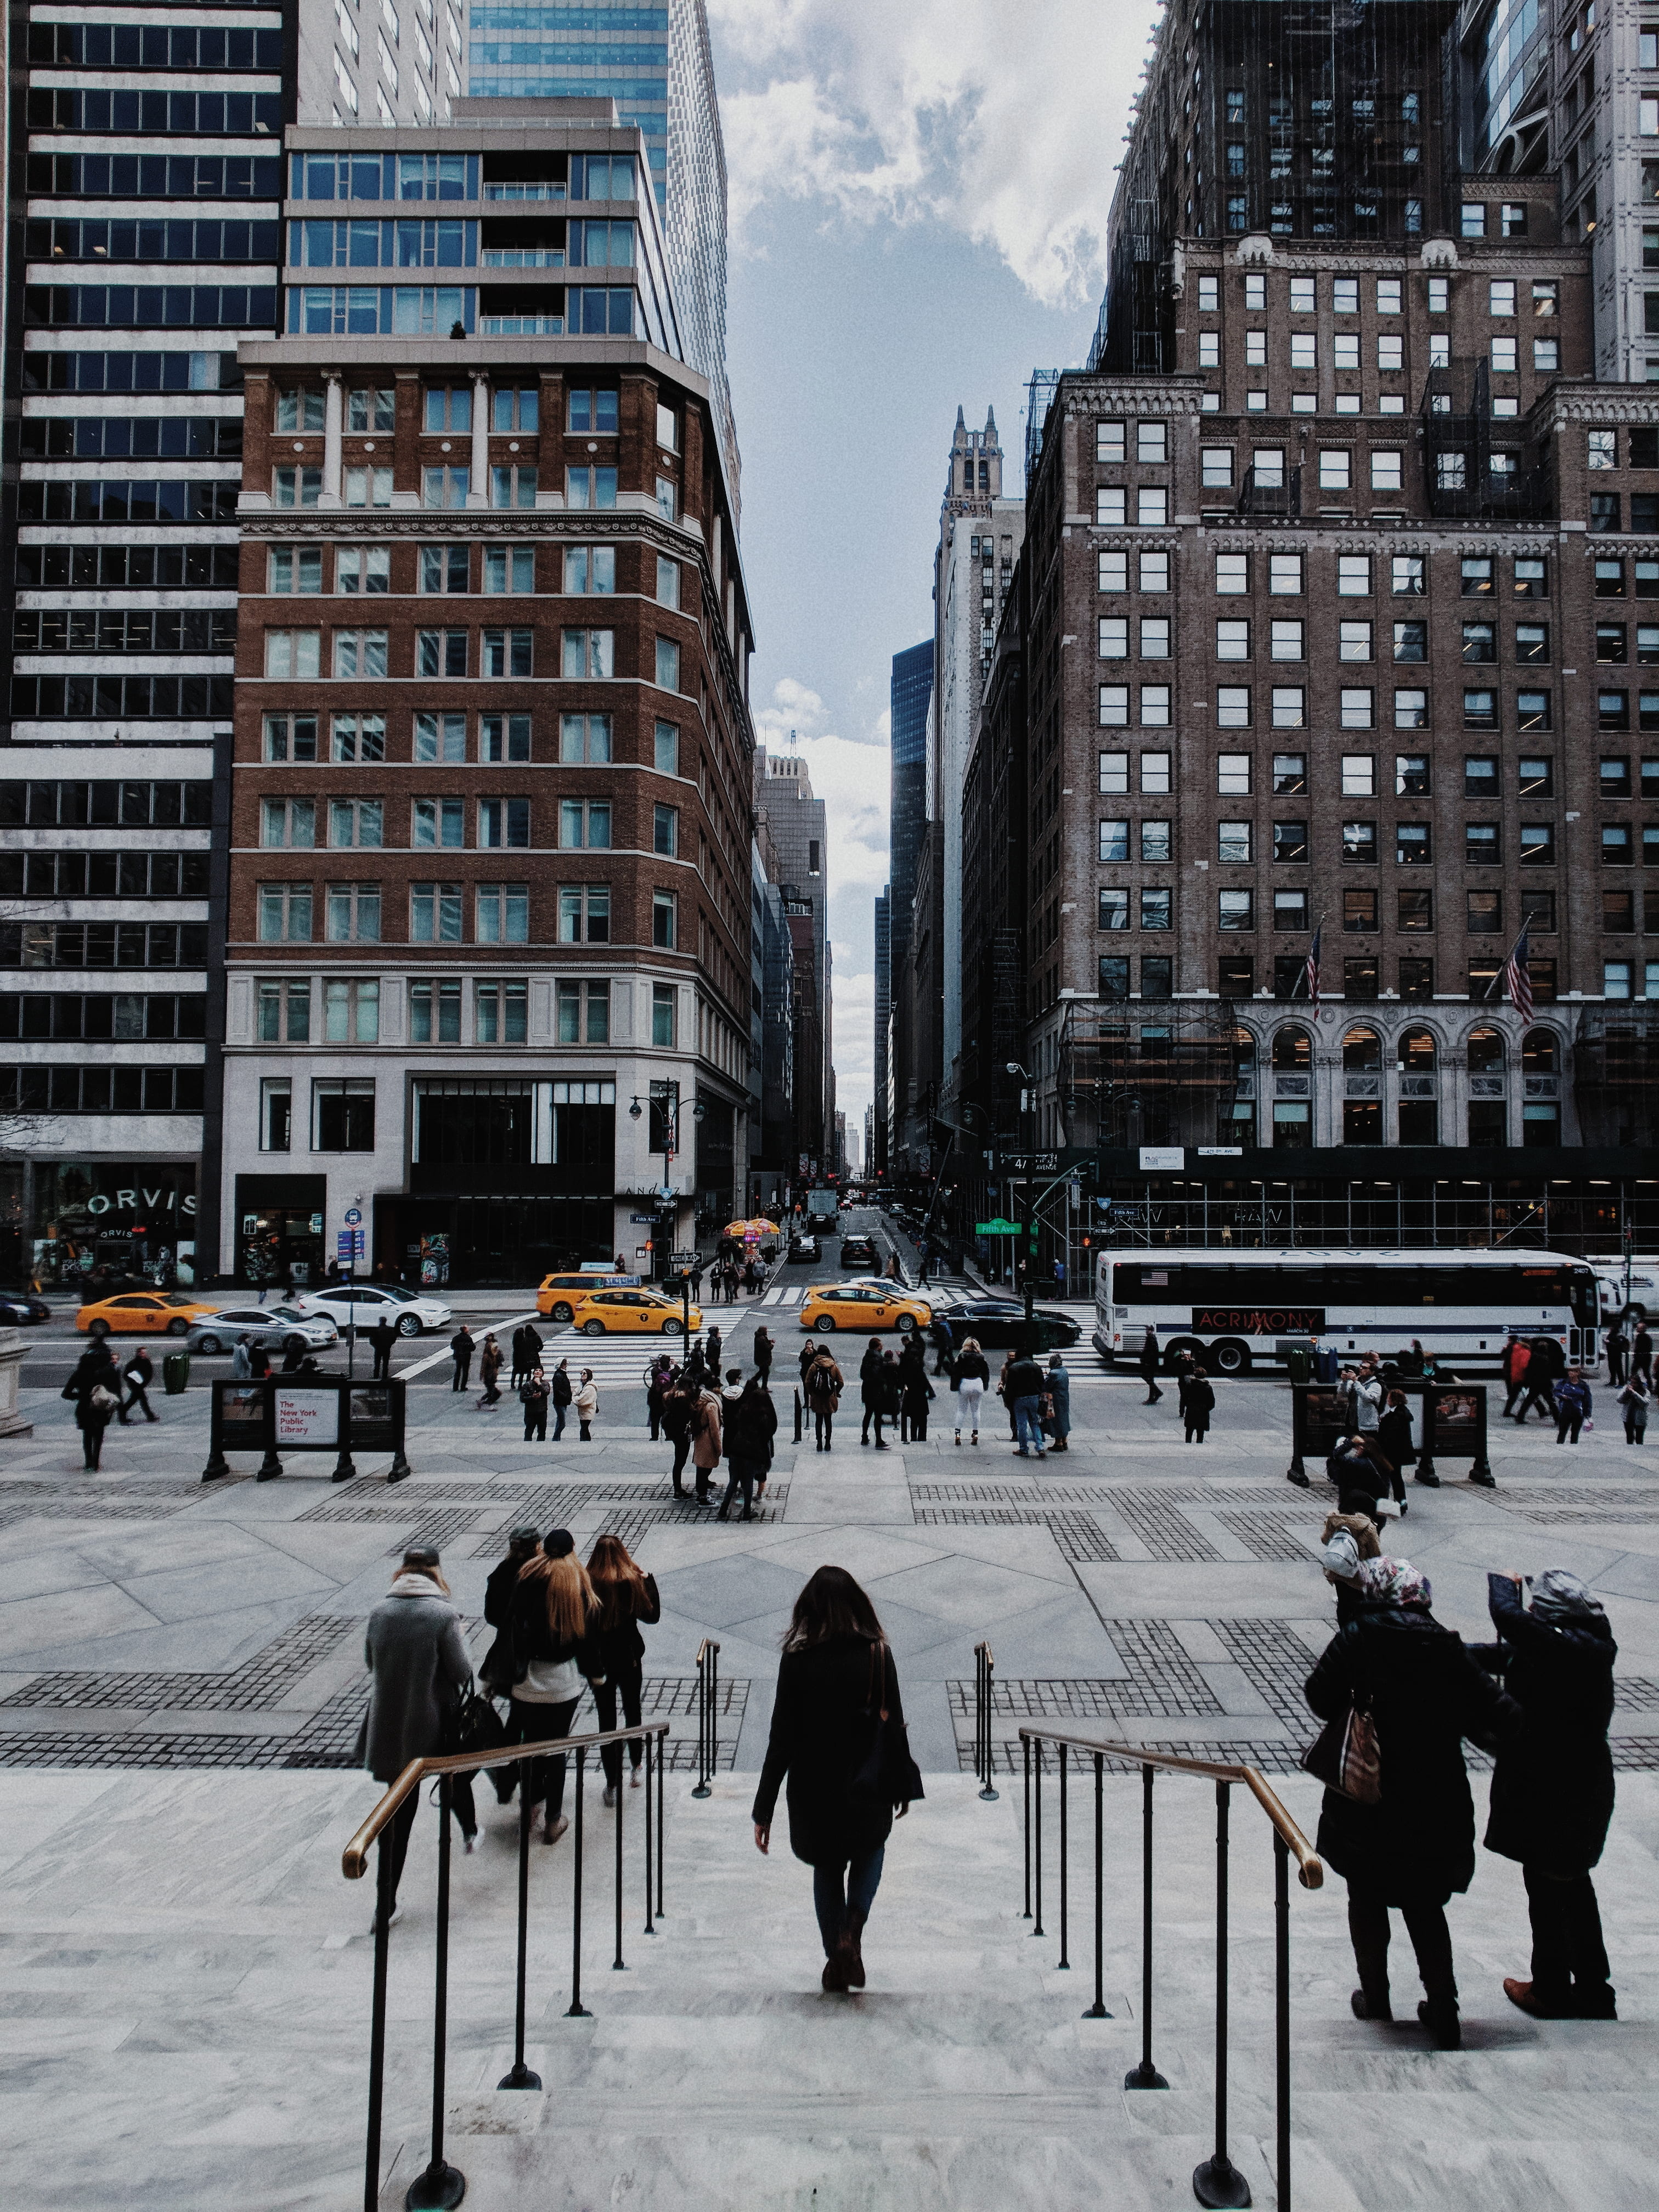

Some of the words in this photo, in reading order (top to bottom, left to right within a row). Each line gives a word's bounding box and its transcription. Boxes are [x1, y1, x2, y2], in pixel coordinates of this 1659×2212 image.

[88, 1188, 196, 1215] ORVIS
[100, 1229, 133, 1238] ORVIS
[1199, 1312, 1317, 1330] ACRIMONY
[280, 1426, 308, 1435] Library
